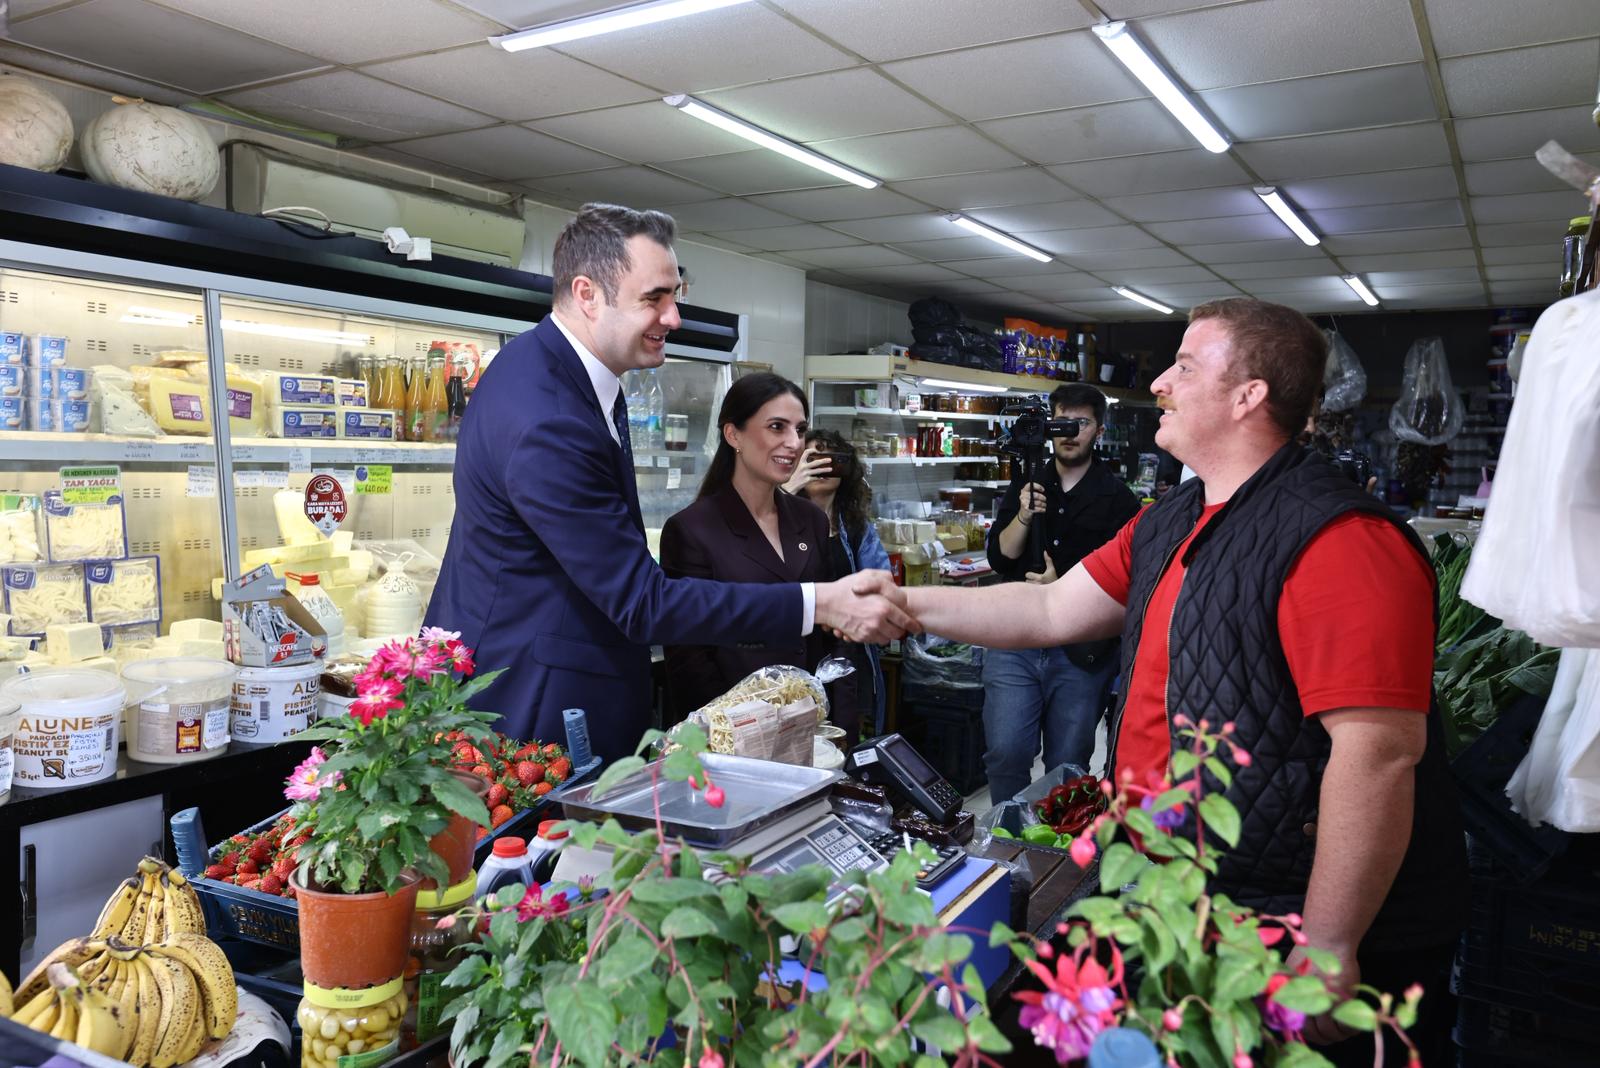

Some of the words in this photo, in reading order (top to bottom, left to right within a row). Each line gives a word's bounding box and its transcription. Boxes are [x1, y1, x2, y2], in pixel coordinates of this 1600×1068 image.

[64, 479, 85, 487] TAM
[307, 505, 344, 514] BURADA!
[19, 717, 94, 734] ALUNE
[13, 739, 49, 748] FISTIK
[13, 748, 53, 756] PEANUT
[20, 771, 27, 780] 5
